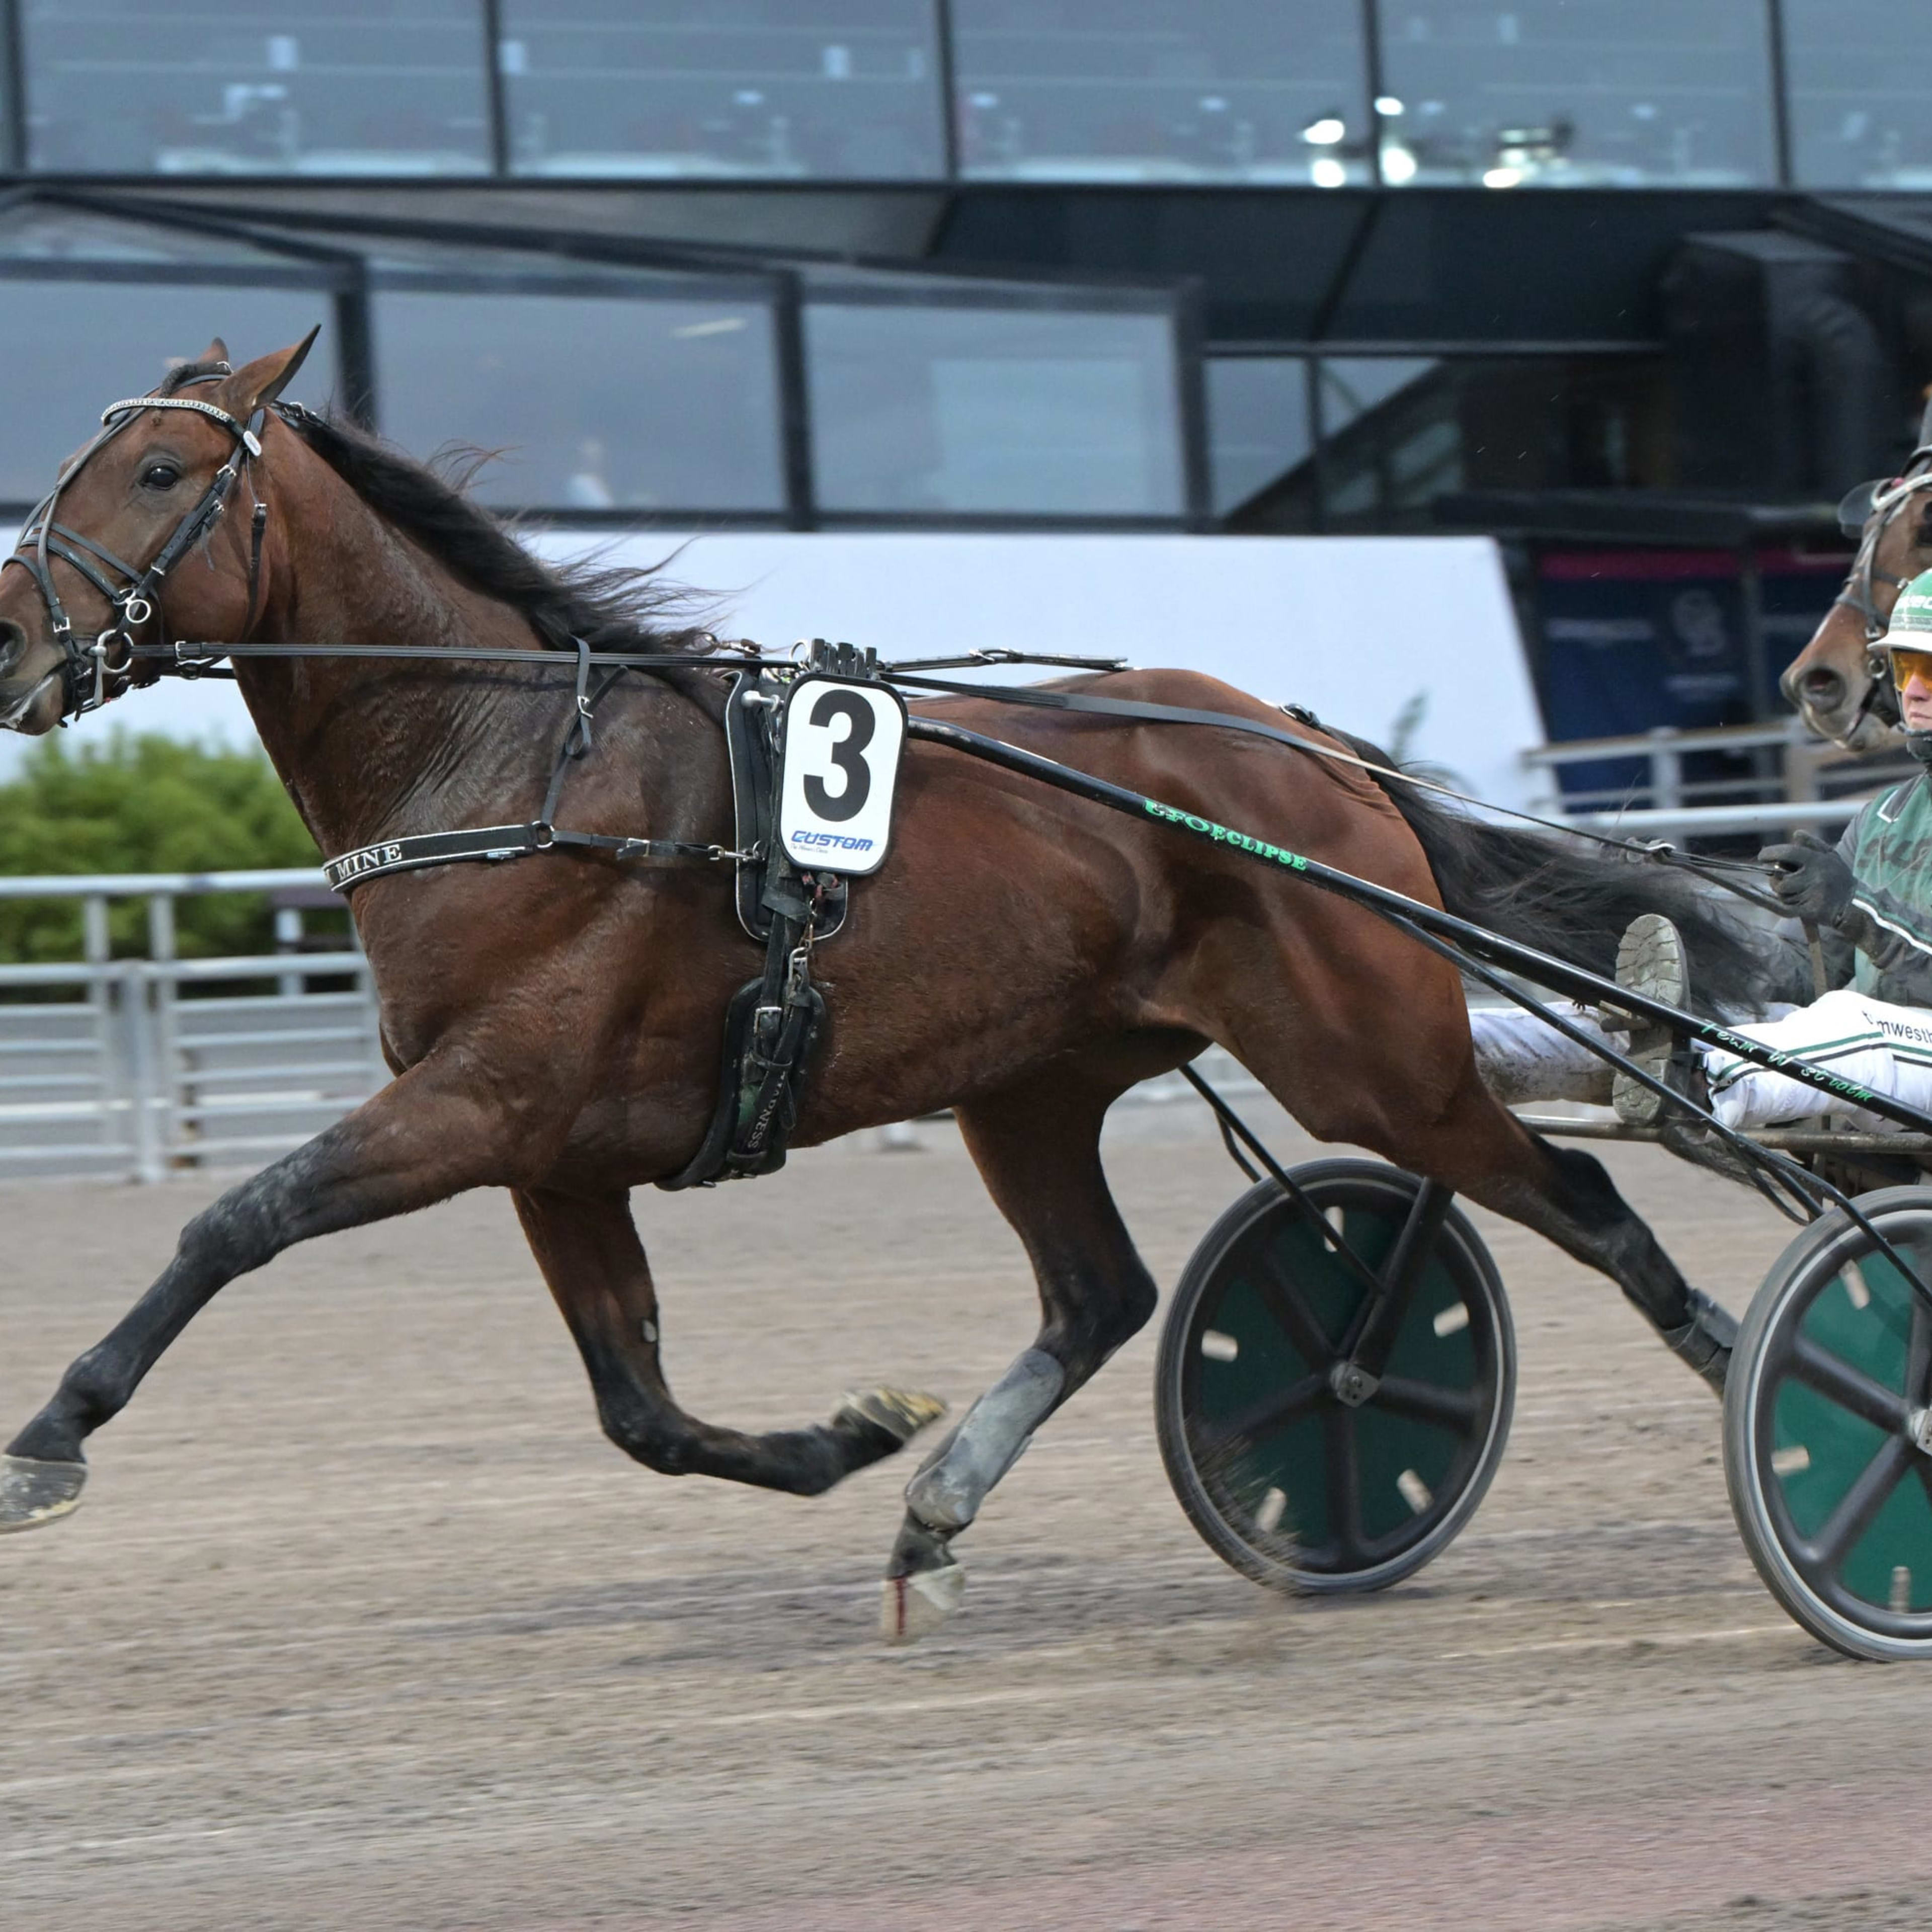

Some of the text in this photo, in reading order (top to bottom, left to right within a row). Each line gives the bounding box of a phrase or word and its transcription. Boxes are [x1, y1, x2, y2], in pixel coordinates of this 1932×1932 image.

[803, 689, 875, 822] 3
[791, 830, 873, 851] CUSTOM
[336, 846, 402, 880] MINE
